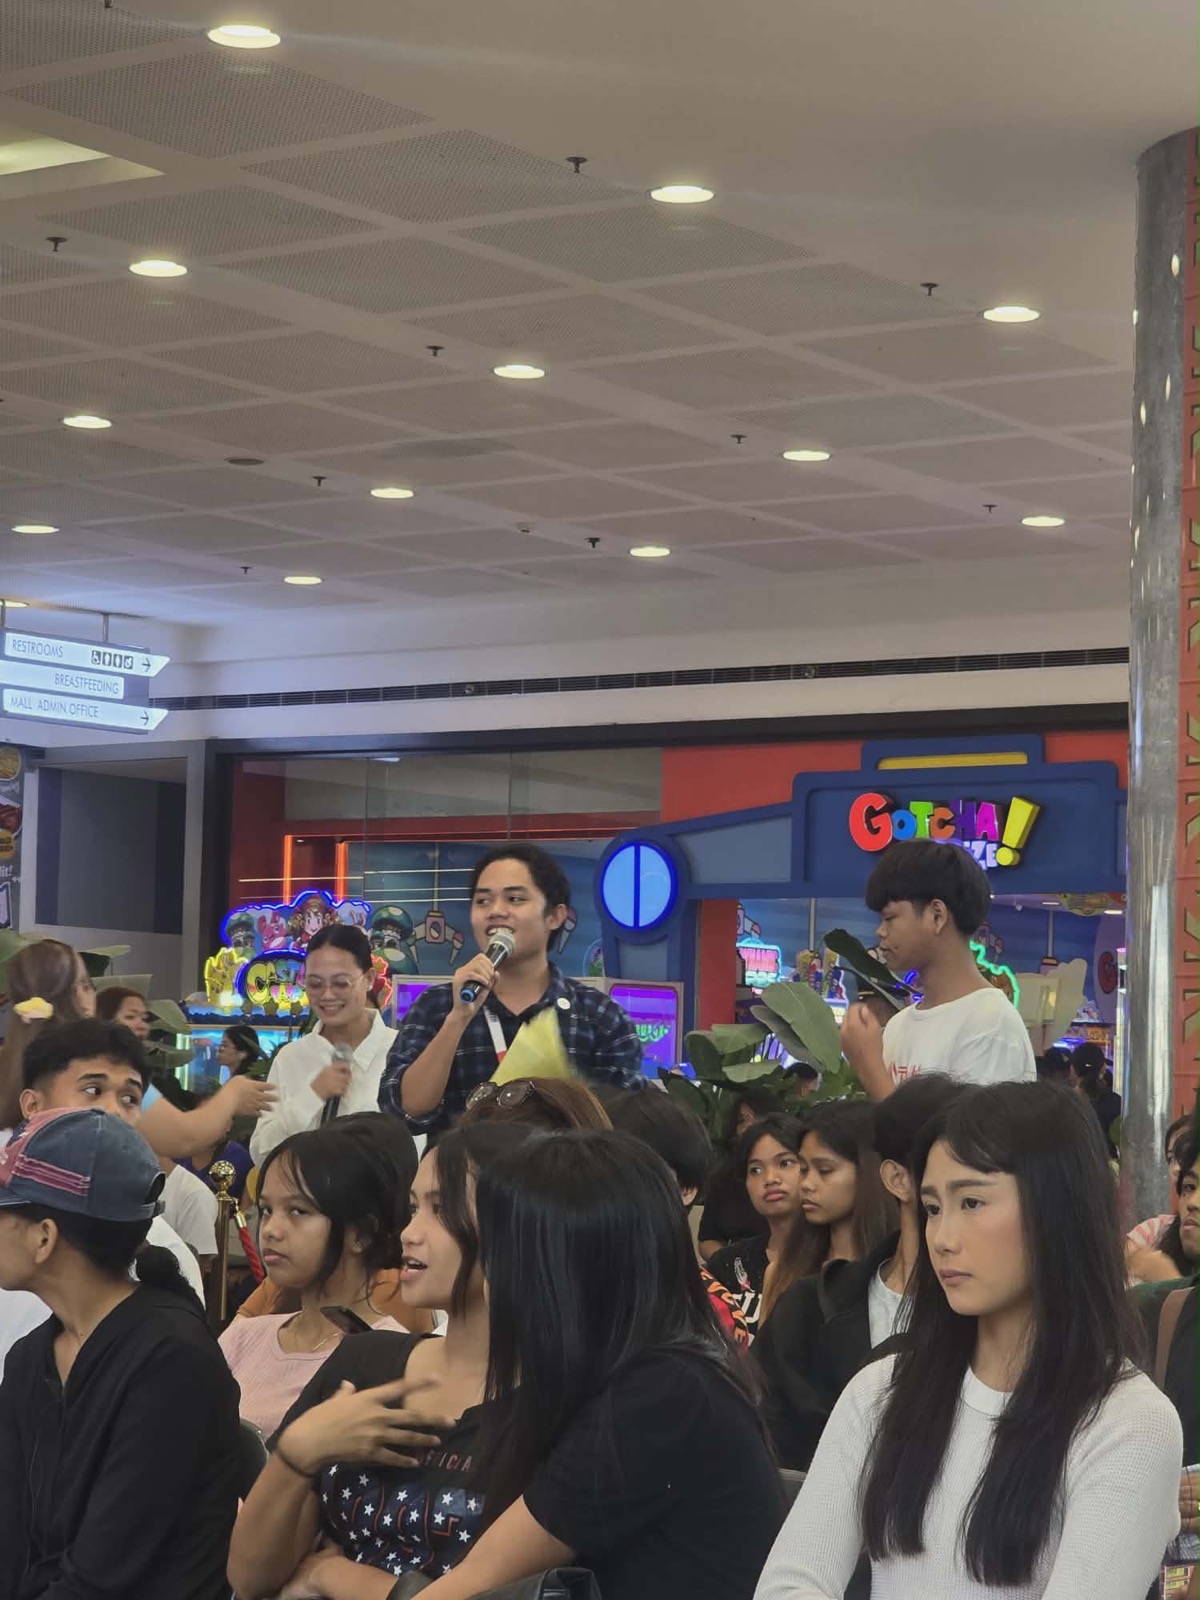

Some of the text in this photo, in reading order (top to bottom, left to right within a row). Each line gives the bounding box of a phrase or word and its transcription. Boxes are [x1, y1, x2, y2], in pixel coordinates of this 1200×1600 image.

[12, 639, 63, 658] RESTROOMS
[54, 674, 120, 694] BREASTFEEDING
[10, 697, 33, 710] MALL
[70, 703, 99, 718] OFFICE
